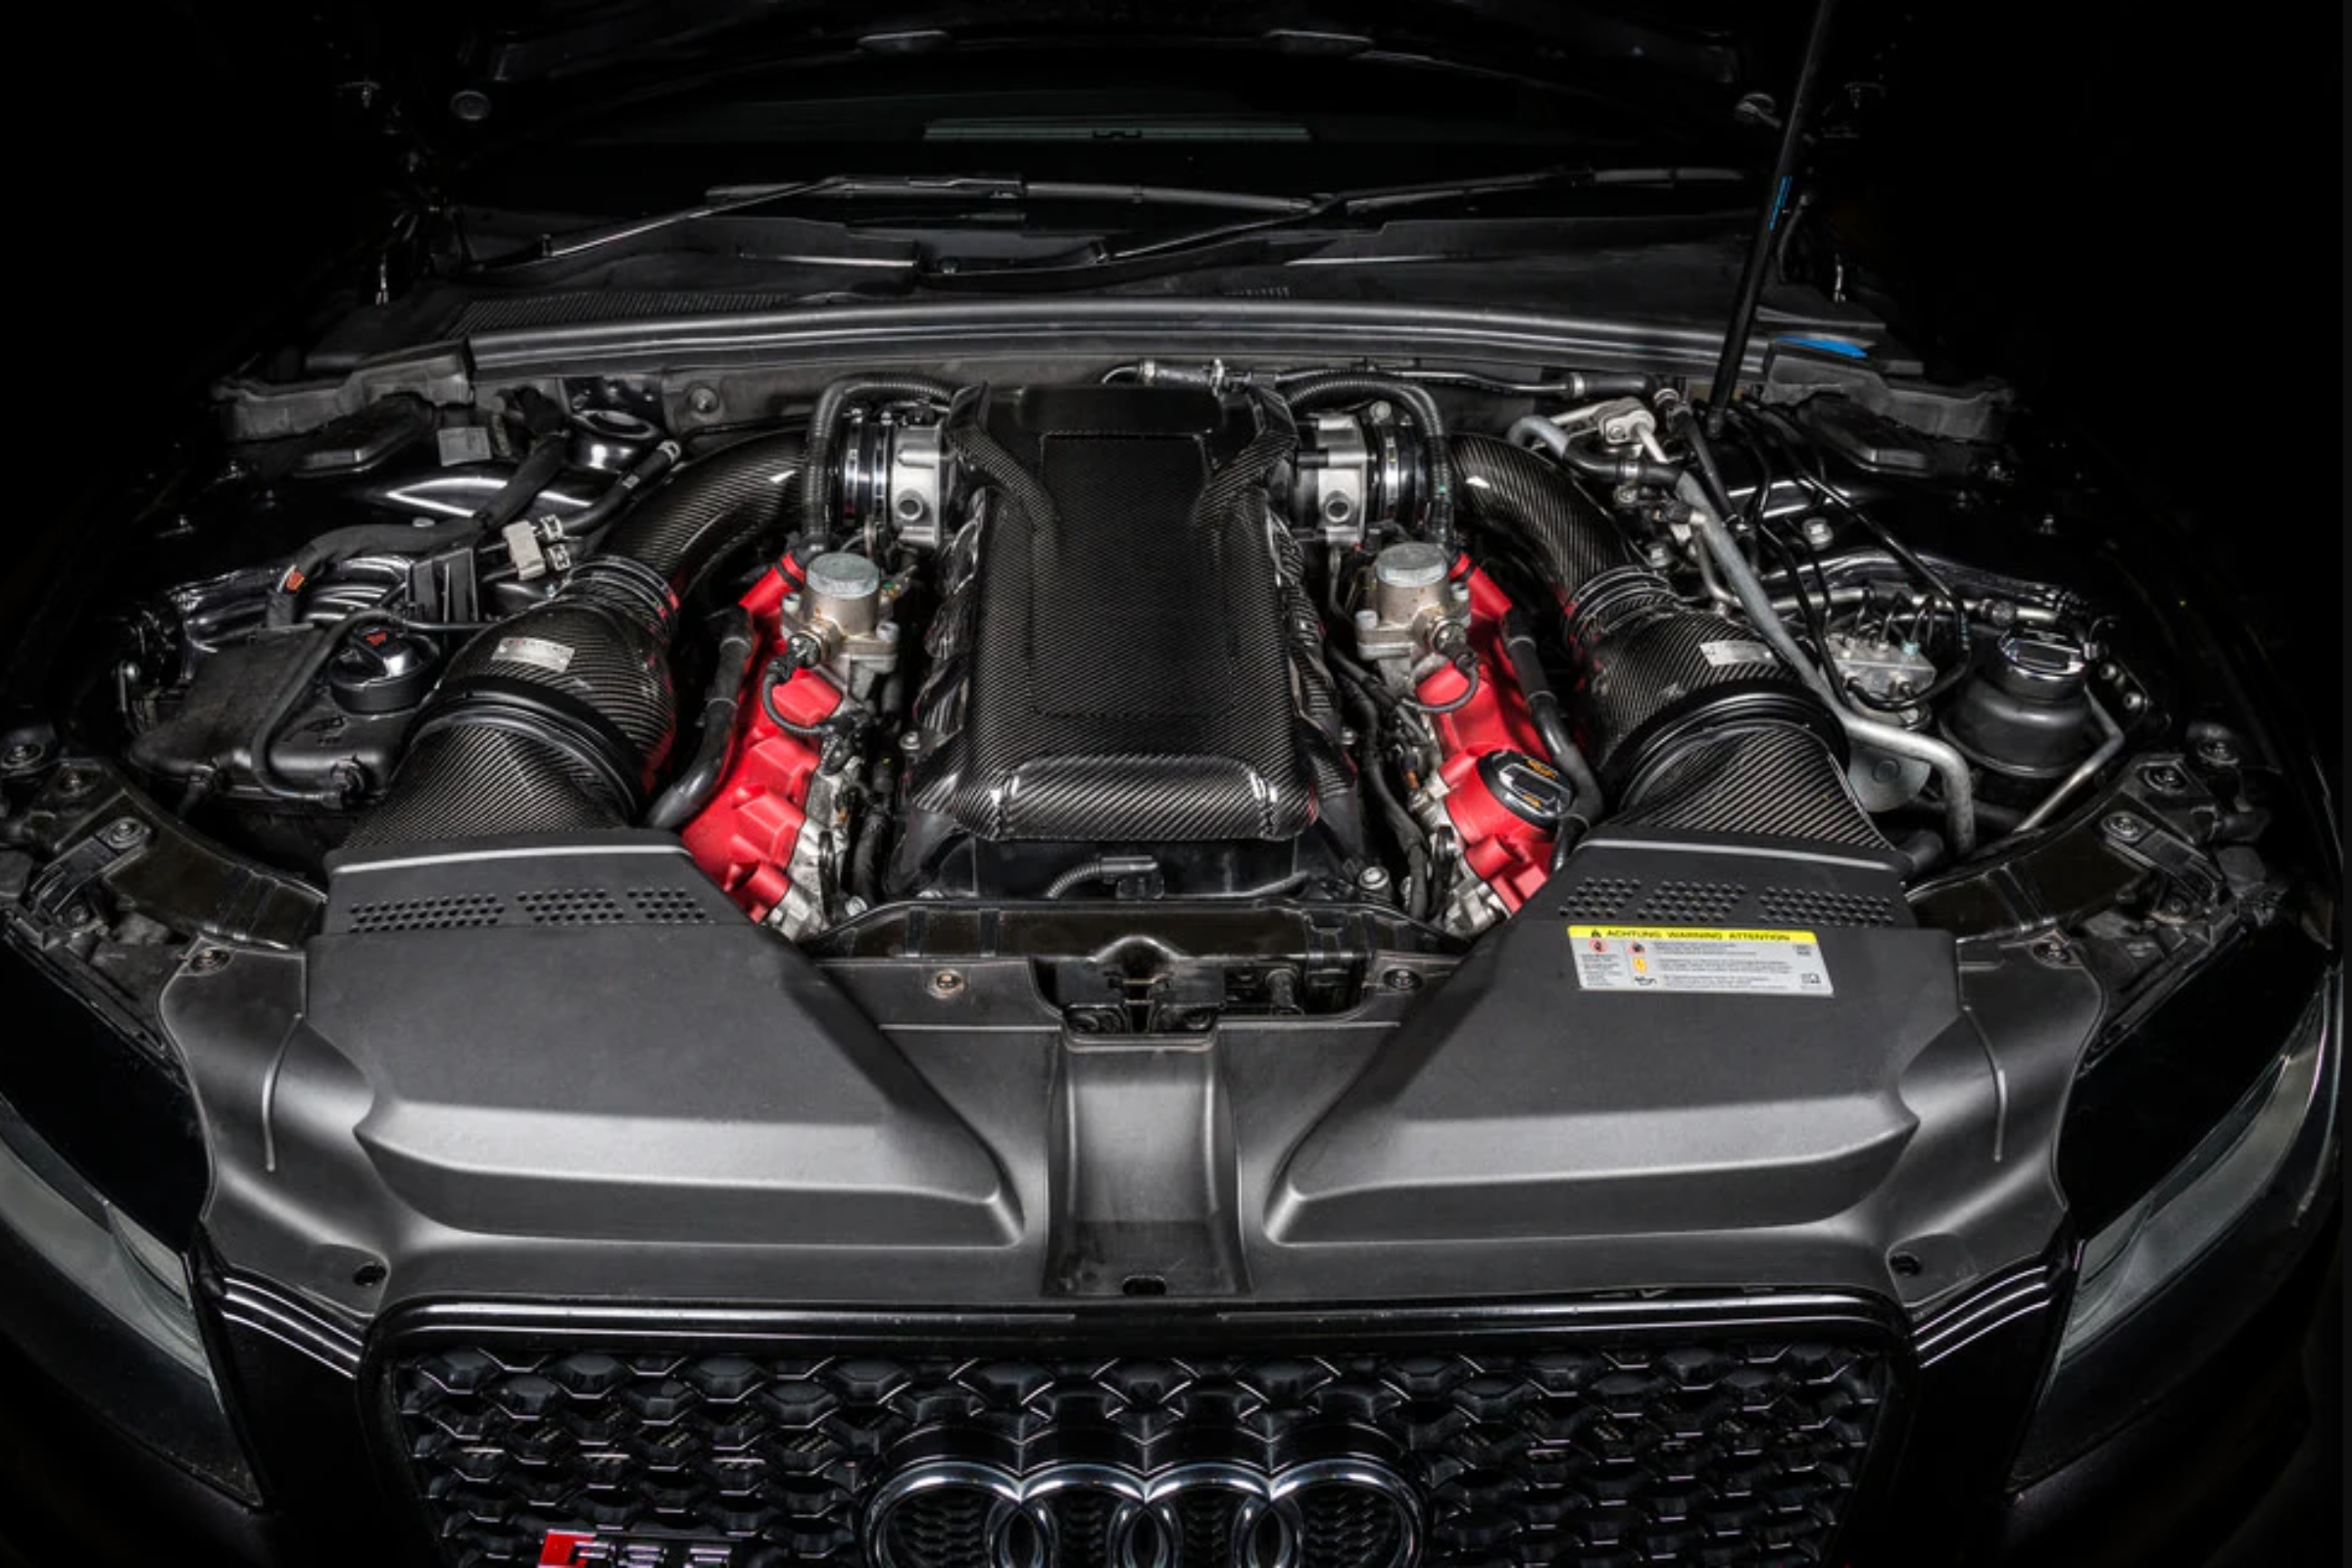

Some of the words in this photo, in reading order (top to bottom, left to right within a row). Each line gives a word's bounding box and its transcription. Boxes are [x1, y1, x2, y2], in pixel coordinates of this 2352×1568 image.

[1605, 929, 1662, 938] ACHTUNG
[1666, 930, 1723, 940] WARNING
[1728, 932, 1790, 941] ATTENTION
